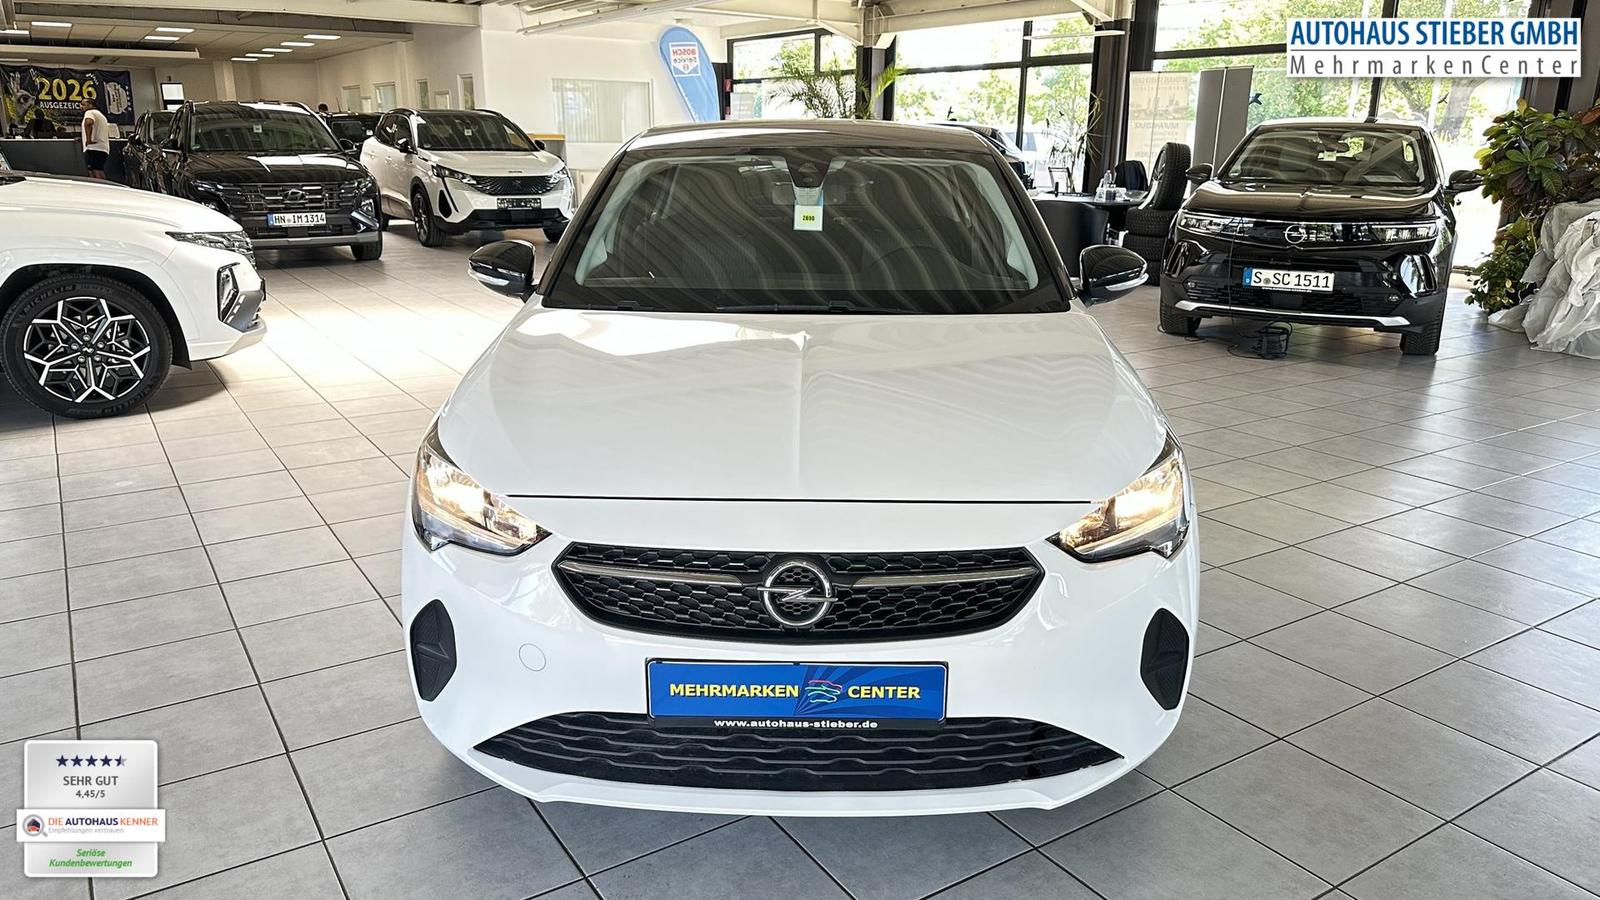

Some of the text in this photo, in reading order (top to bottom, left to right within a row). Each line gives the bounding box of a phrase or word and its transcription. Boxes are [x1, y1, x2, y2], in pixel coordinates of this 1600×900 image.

[38, 78, 97, 101] 2026
[39, 101, 80, 109] AUSGEZEIC
[274, 215, 286, 224] HN
[304, 214, 325, 223] 1314
[1253, 271, 1330, 289] S SC 1511
[669, 683, 920, 699] MEHRMARKEN CENTER
[714, 719, 878, 729] www.autohaus-stieber.de
